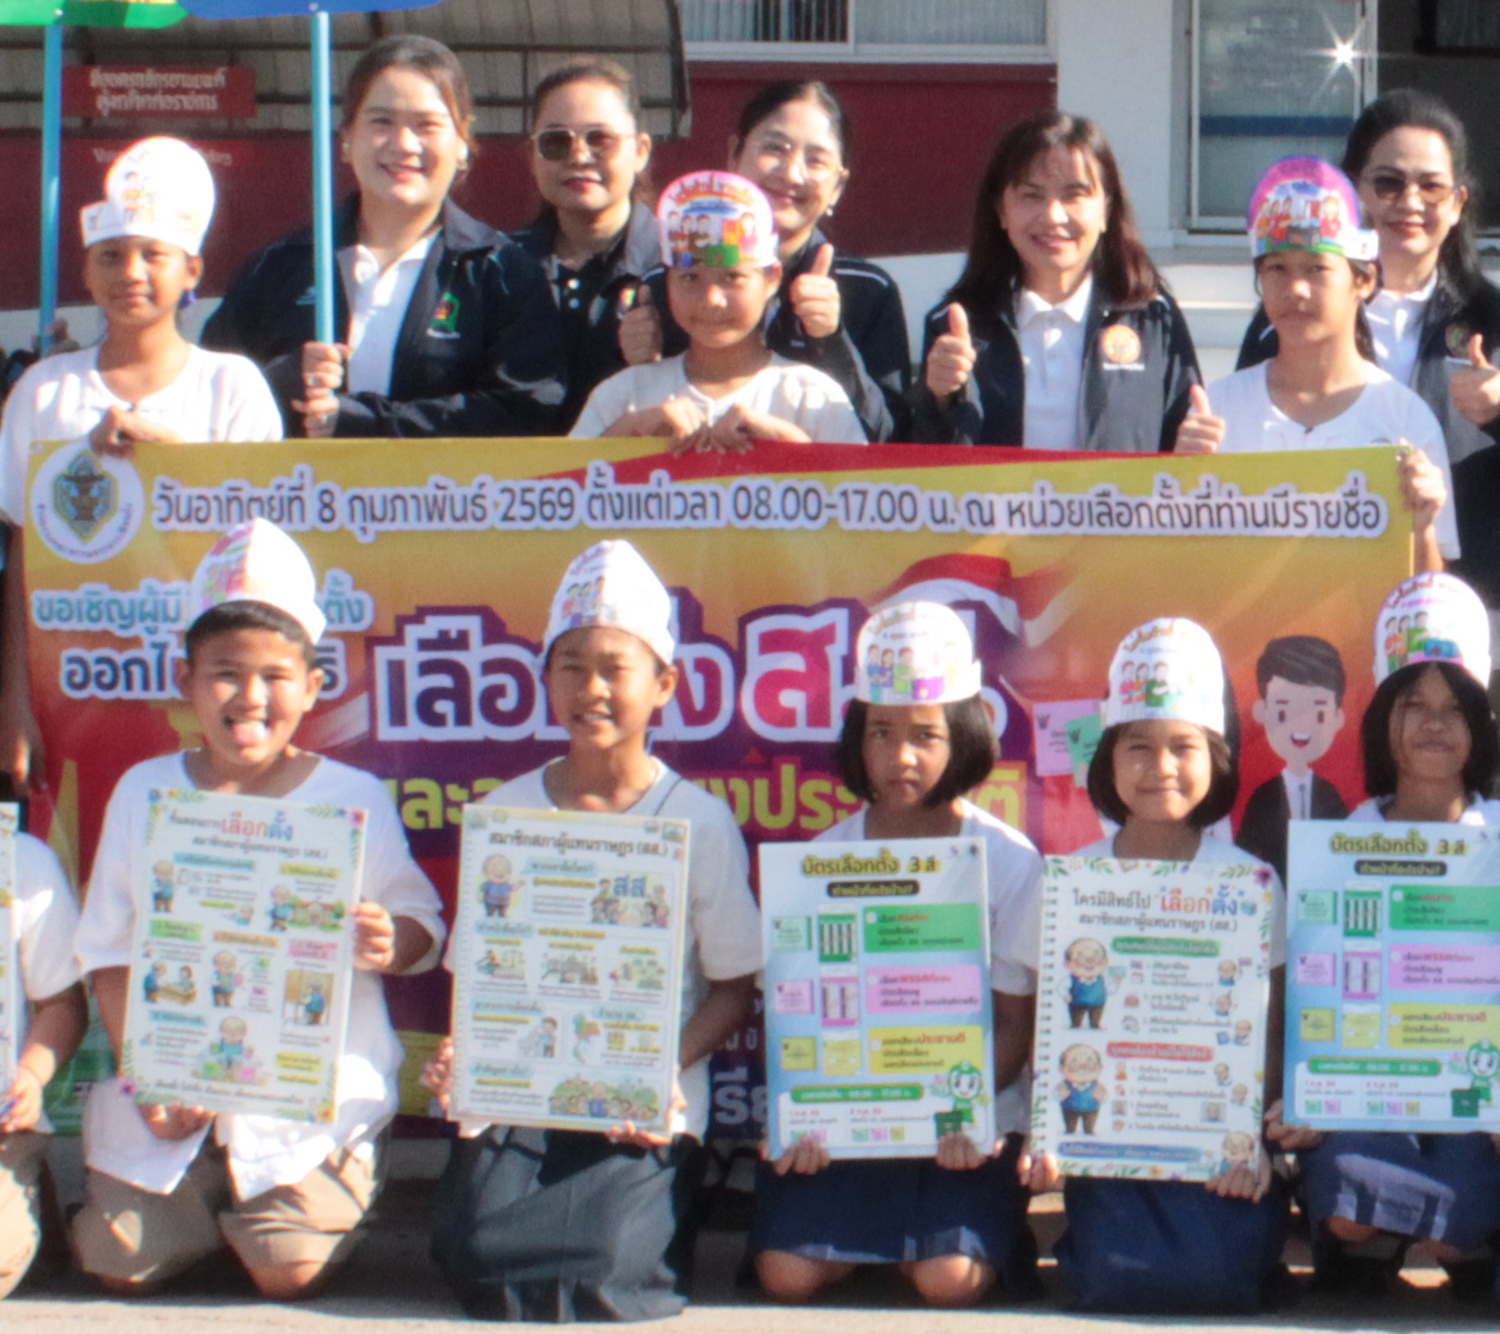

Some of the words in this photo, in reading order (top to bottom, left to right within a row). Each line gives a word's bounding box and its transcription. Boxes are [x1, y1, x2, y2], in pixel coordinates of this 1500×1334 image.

[155, 471, 305, 525] วันอาทิตย์ที่
[318, 489, 336, 524] 8
[348, 481, 487, 539] กุมภาพันธ์
[500, 488, 575, 524] 2569
[587, 468, 722, 523] ตั้งแต่เวลา
[732, 485, 919, 525] 08.00-17.00
[930, 495, 957, 525] น.
[965, 497, 996, 528] ณ
[1007, 475, 1381, 533] หน่วยเลือกตั้งที่ท่านมีรายชื่อ
[1330, 829, 1430, 855] บัตรเลือกตั้ง
[1439, 839, 1450, 854] 3
[802, 847, 900, 876] บัตรเลือกตั้ง
[909, 856, 921, 874] 3
[1160, 883, 1239, 916] เลือกตั้ง
